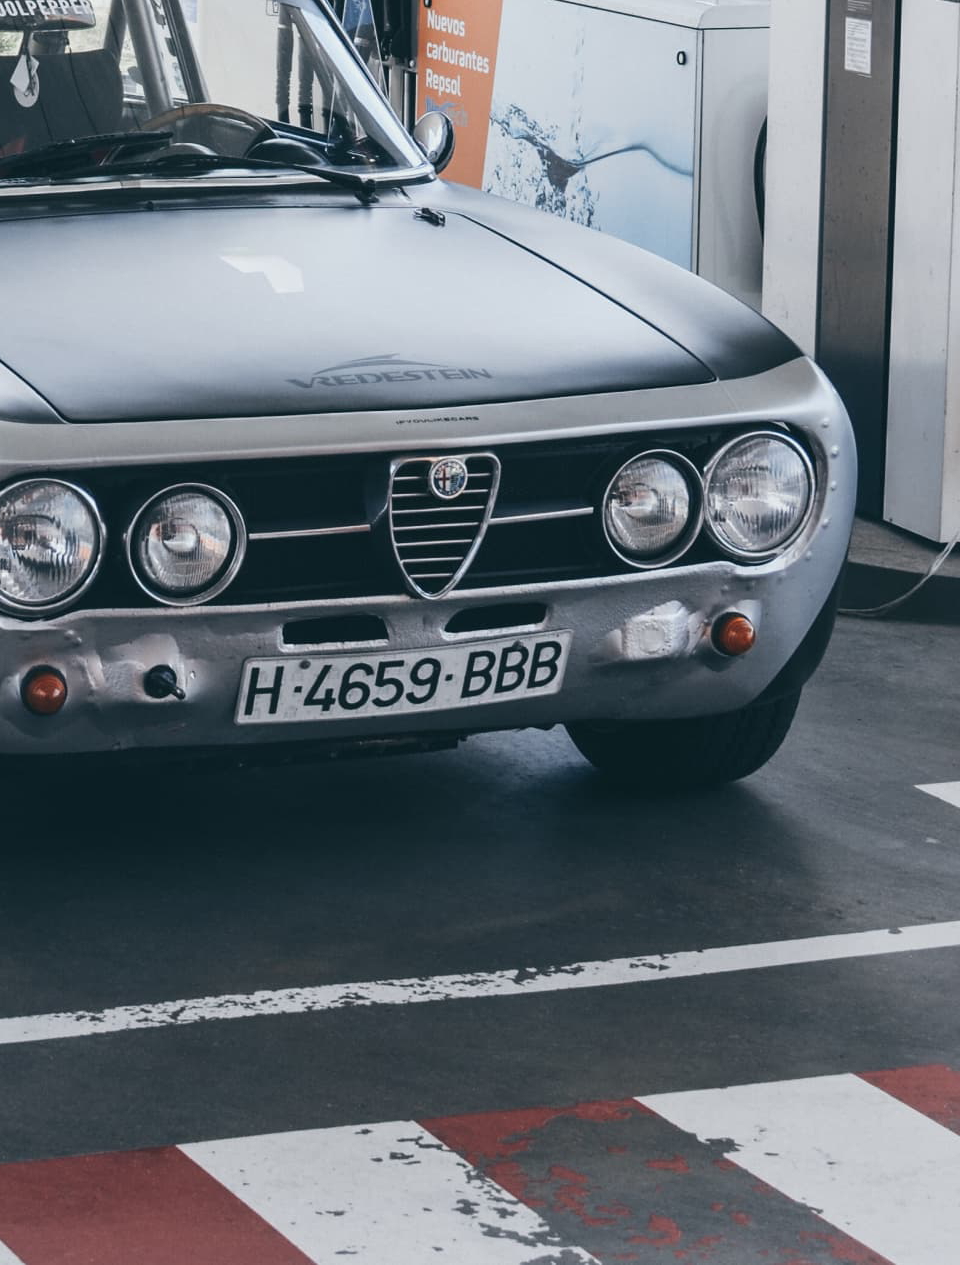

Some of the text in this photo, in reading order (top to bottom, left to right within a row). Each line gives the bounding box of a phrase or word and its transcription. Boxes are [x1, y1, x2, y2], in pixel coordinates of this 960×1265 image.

[427, 9, 465, 37] Nuevos
[426, 41, 490, 74] carburantes
[425, 68, 462, 96] Repsol
[284, 367, 494, 389] VREDESTEIN
